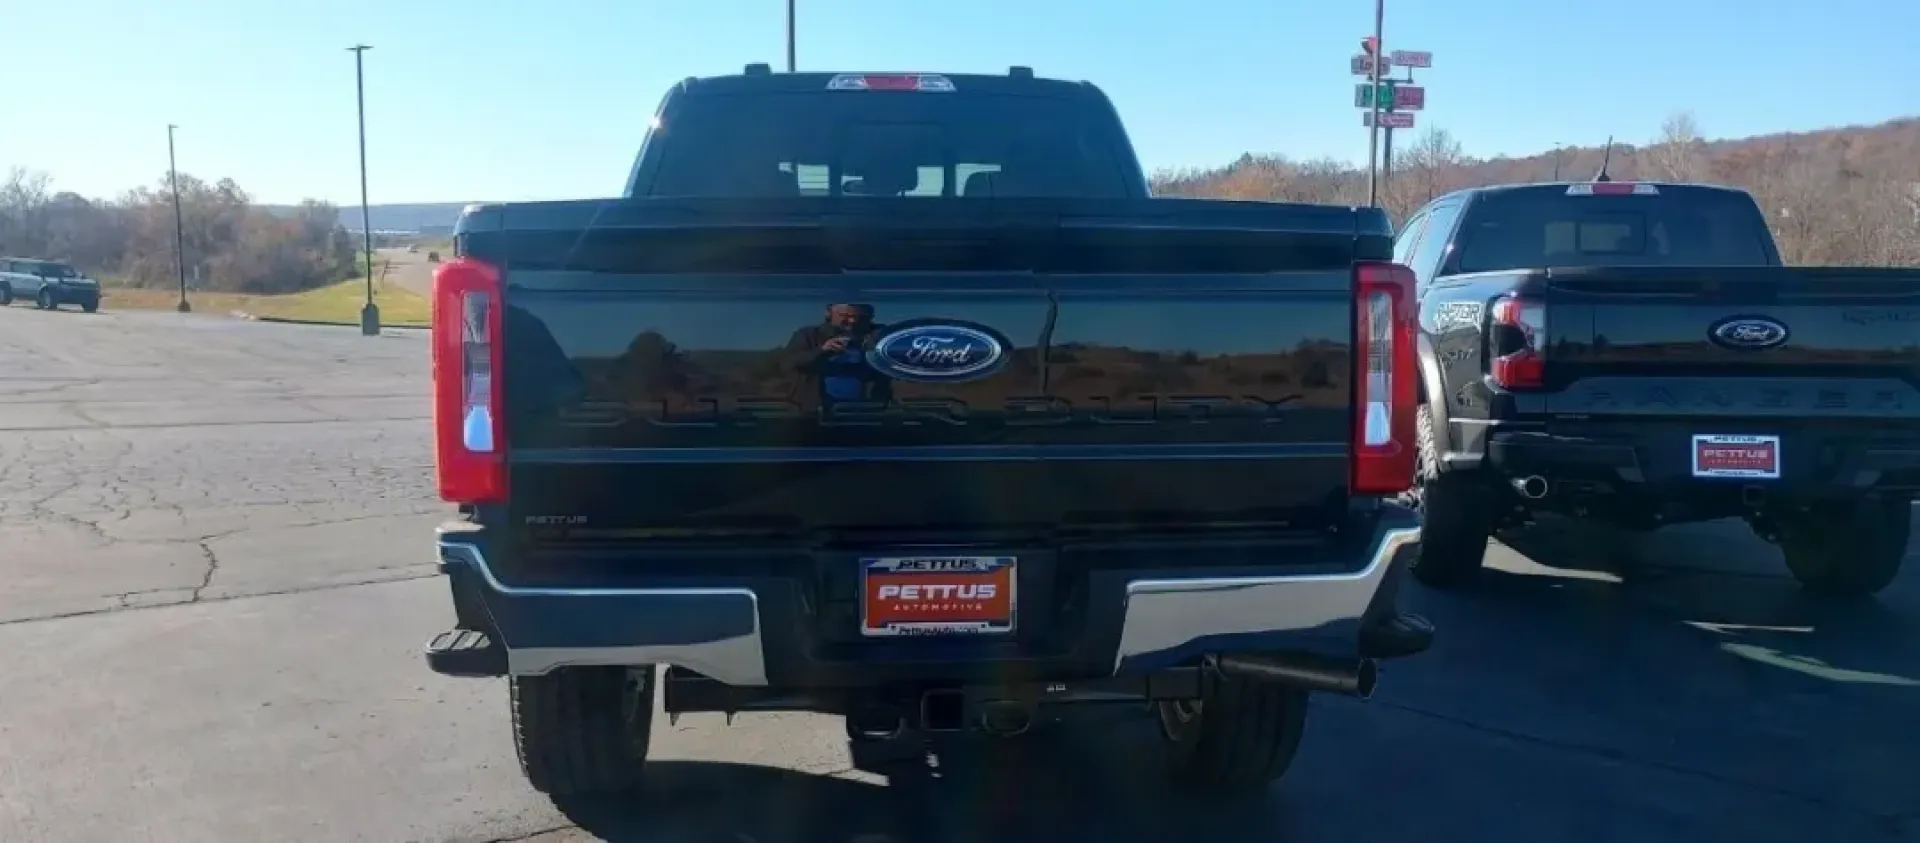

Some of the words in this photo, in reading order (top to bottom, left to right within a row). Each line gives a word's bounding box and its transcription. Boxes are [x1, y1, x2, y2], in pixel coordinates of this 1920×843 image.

[906, 335, 972, 363] Ford
[1003, 394, 1304, 425] DUTY
[1703, 449, 1769, 459] PETTUS
[898, 558, 980, 571] PETTUS
[877, 583, 999, 601] PETTUS
[892, 603, 983, 612] AUTOMOTIVE
